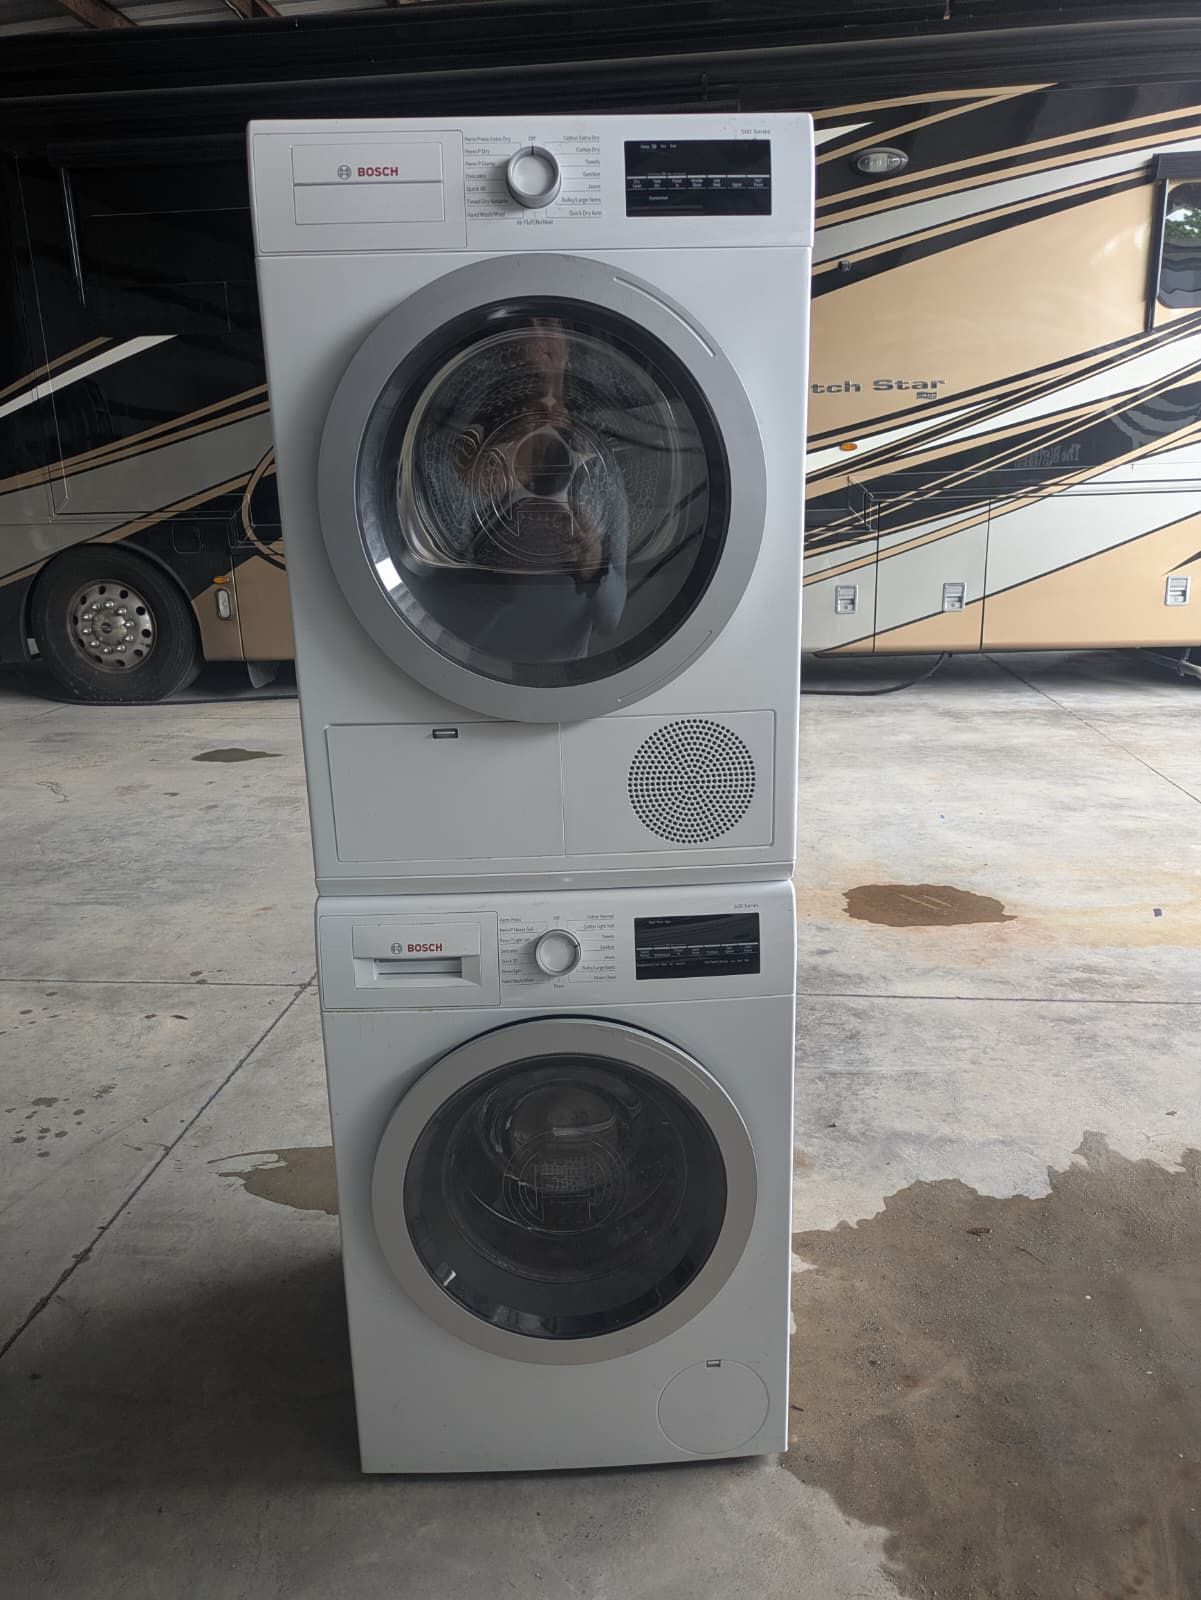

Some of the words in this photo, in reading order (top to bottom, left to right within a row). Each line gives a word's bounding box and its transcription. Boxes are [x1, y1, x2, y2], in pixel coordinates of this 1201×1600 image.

[358, 167, 399, 177] BOSCH
[811, 380, 861, 394] tch
[873, 379, 945, 391] Star
[408, 943, 443, 953] BOSCH
